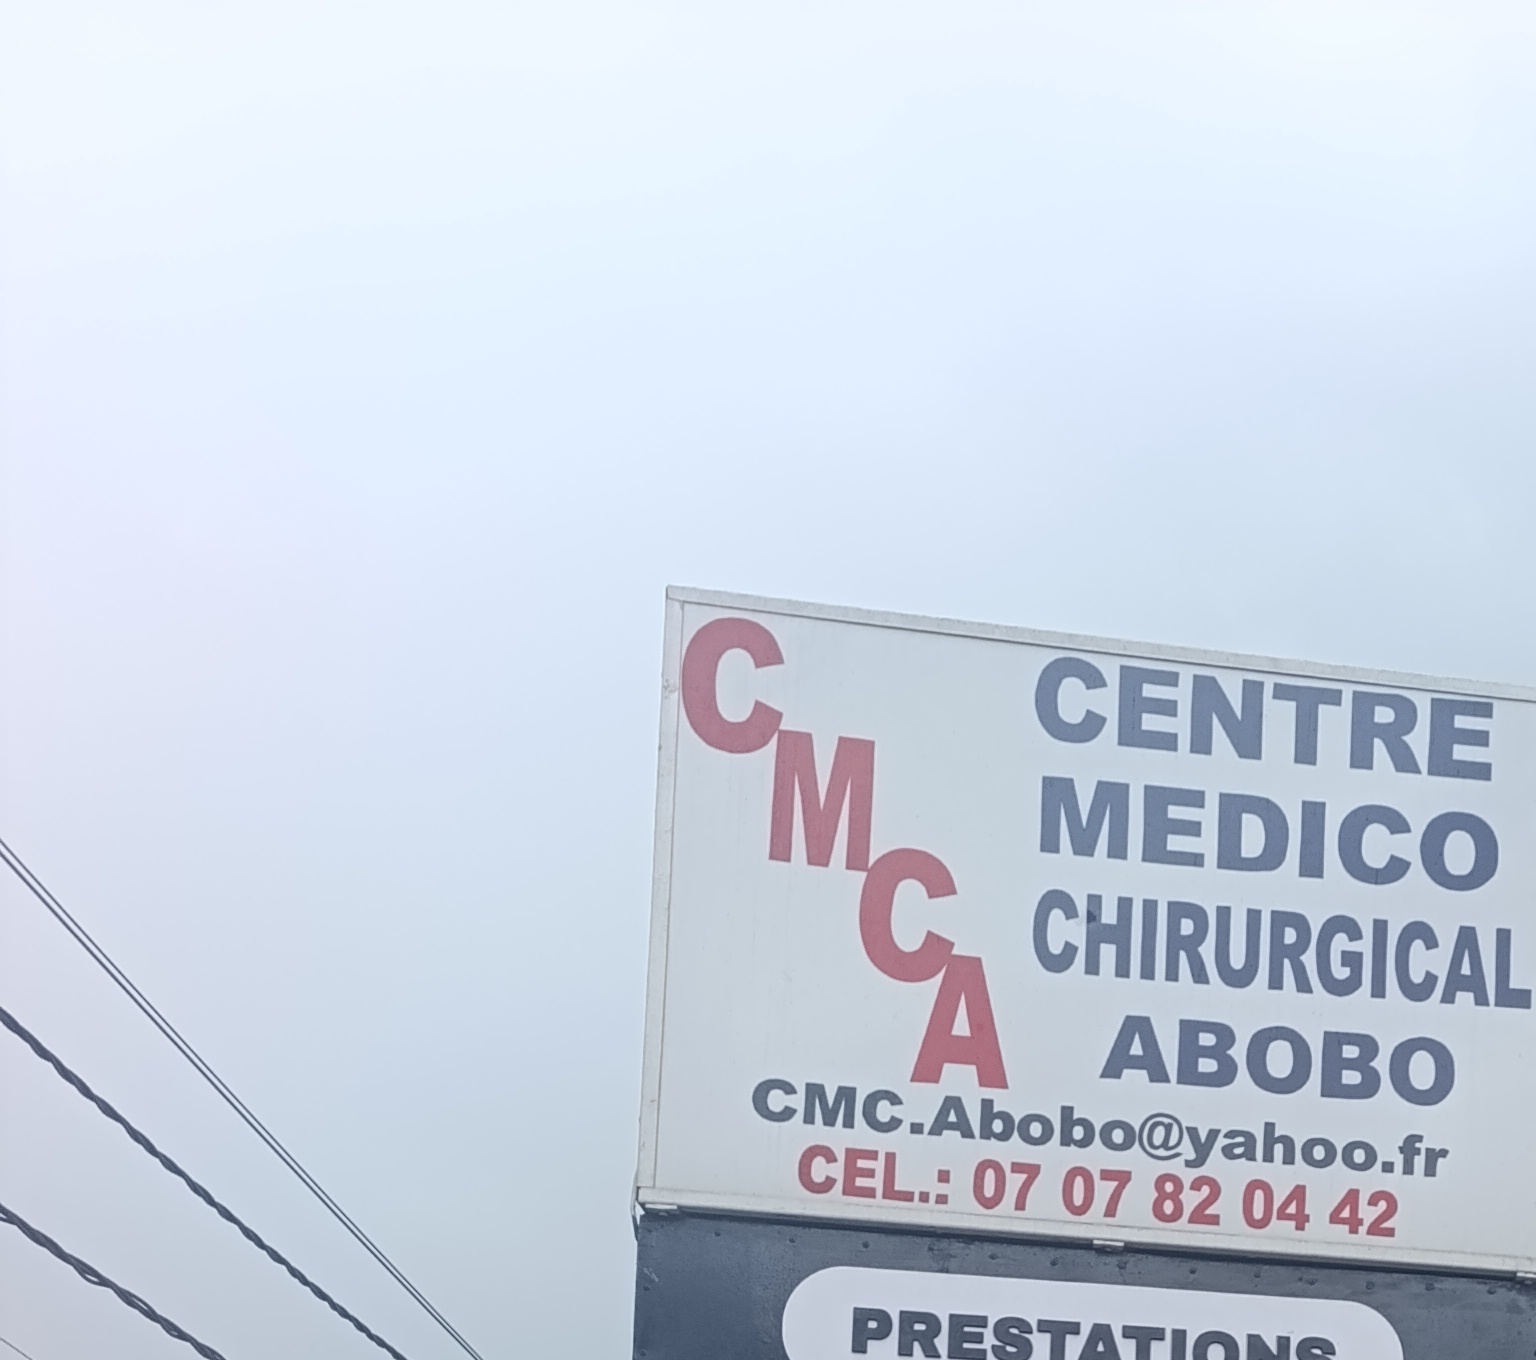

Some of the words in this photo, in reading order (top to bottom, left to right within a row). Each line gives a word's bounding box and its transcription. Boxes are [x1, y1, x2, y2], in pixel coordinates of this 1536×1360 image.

[1035, 657, 1494, 782] CENTRE
[1040, 777, 1499, 892] MEDICO
[1032, 889, 1532, 1010] CHIRURGICAL
[1100, 1015, 1455, 1107] ABOBO
[751, 1078, 1450, 1179] CMC.Abobo@yahoo.fr
[797, 1144, 951, 1205] CEL.:
[973, 1159, 1040, 1210] 07
[1063, 1167, 1132, 1218] 07
[1153, 1174, 1222, 1227] 82
[1242, 1178, 1311, 1231] 04
[1329, 1187, 1399, 1238] 42
